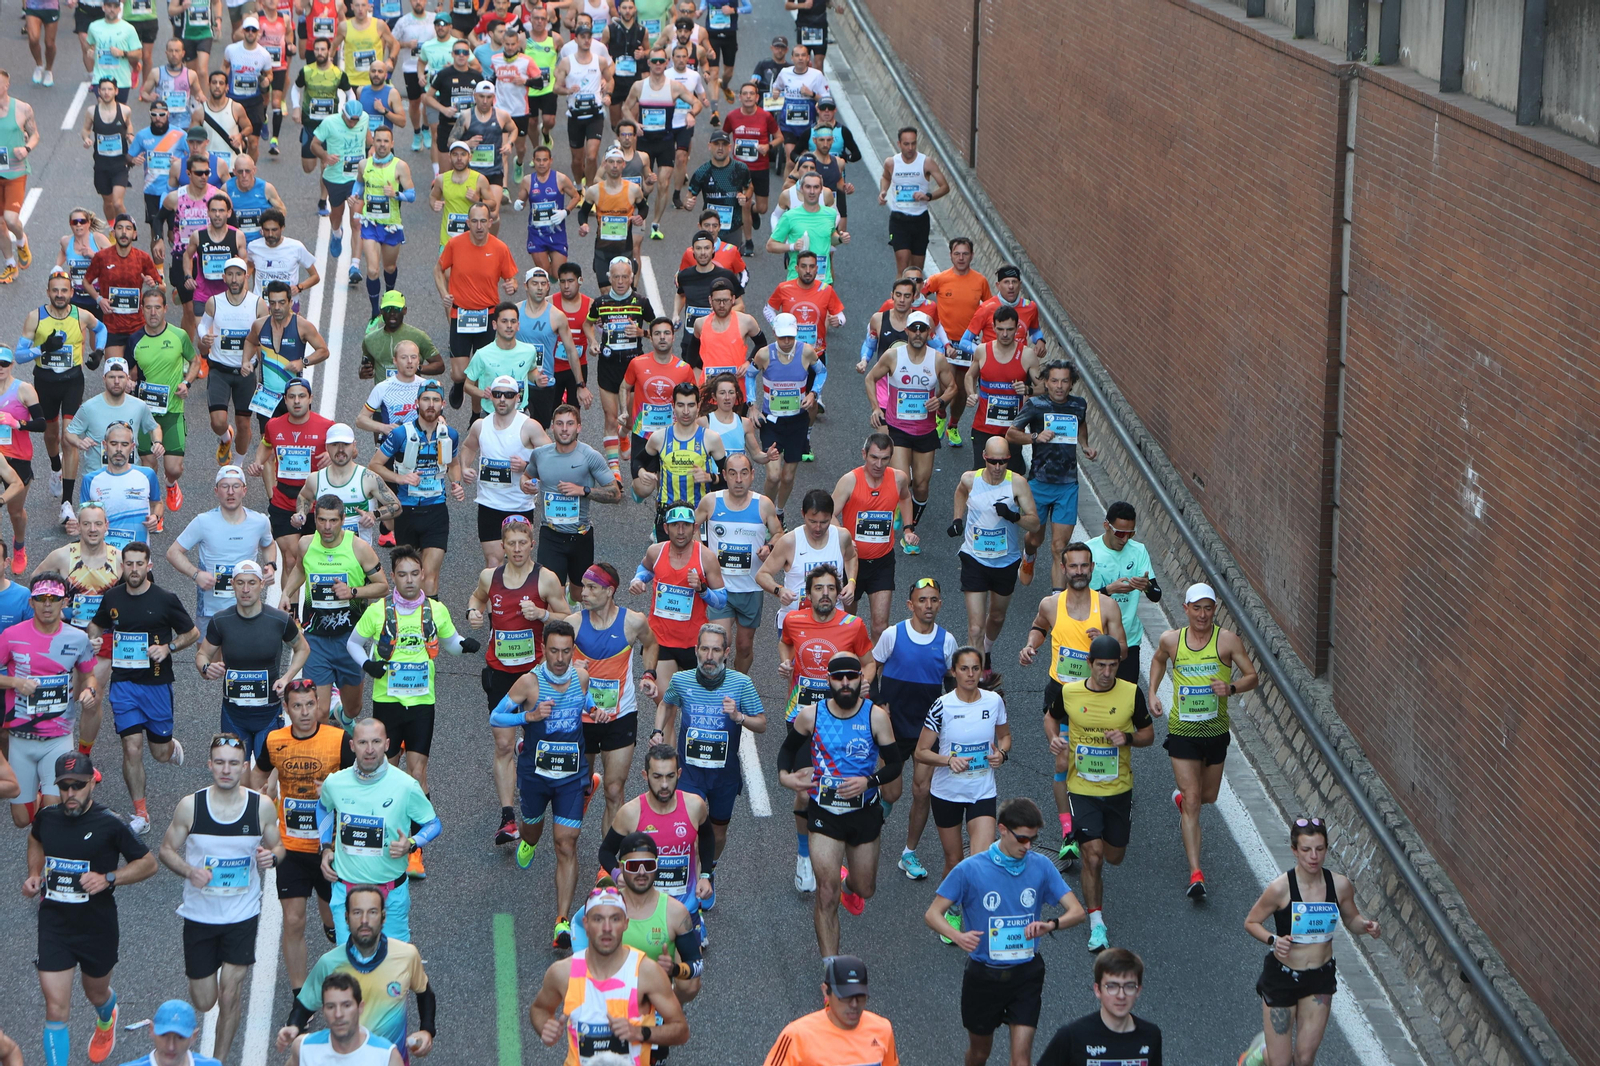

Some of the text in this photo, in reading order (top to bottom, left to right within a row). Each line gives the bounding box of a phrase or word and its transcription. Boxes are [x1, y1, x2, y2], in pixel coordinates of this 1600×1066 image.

[669, 587, 689, 595] ZURICH
[1072, 651, 1088, 659] ZURIC
[354, 817, 378, 825] ZURICH
[59, 862, 83, 870] ZURICH
[1007, 918, 1030, 926] ZURICH
[593, 1025, 610, 1033] ZURI
